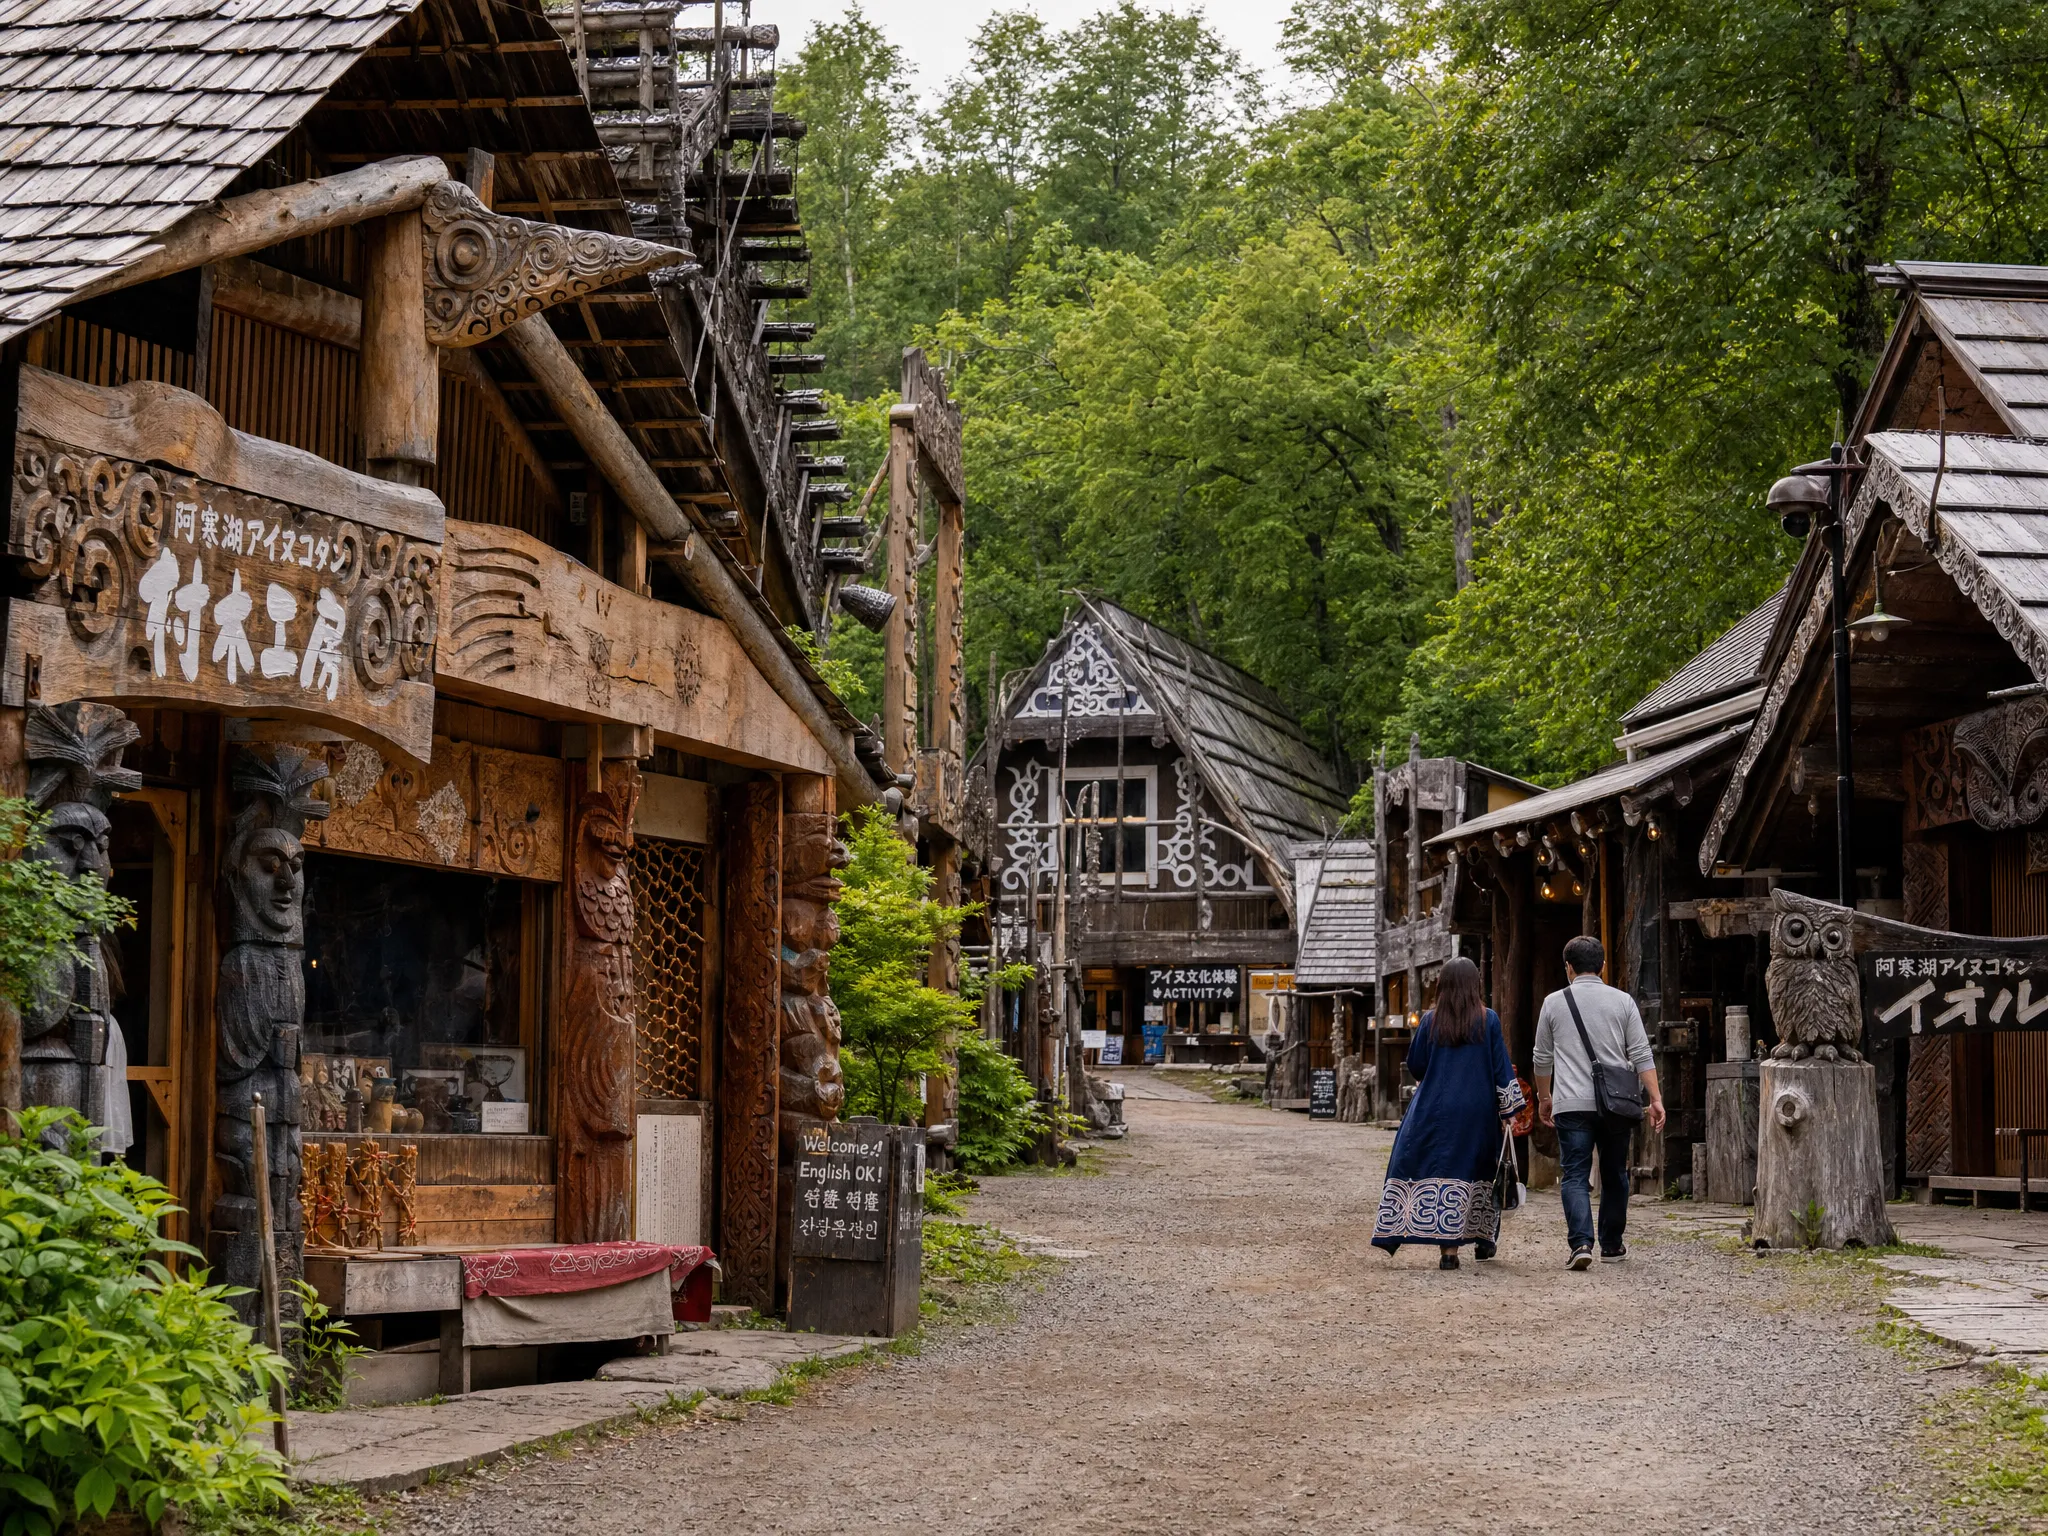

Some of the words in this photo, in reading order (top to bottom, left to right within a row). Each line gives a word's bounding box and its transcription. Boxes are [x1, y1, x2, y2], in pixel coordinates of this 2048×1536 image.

[174, 501, 347, 573] 阿寒湖アイヌコタン
[1150, 969, 1237, 984] アイヌ文化体験
[1875, 957, 2033, 979] 阿寒湖アイヌコタン
[1879, 979, 2048, 1034] イオル
[800, 1161, 851, 1185] English
[855, 1165, 882, 1183] OK!
